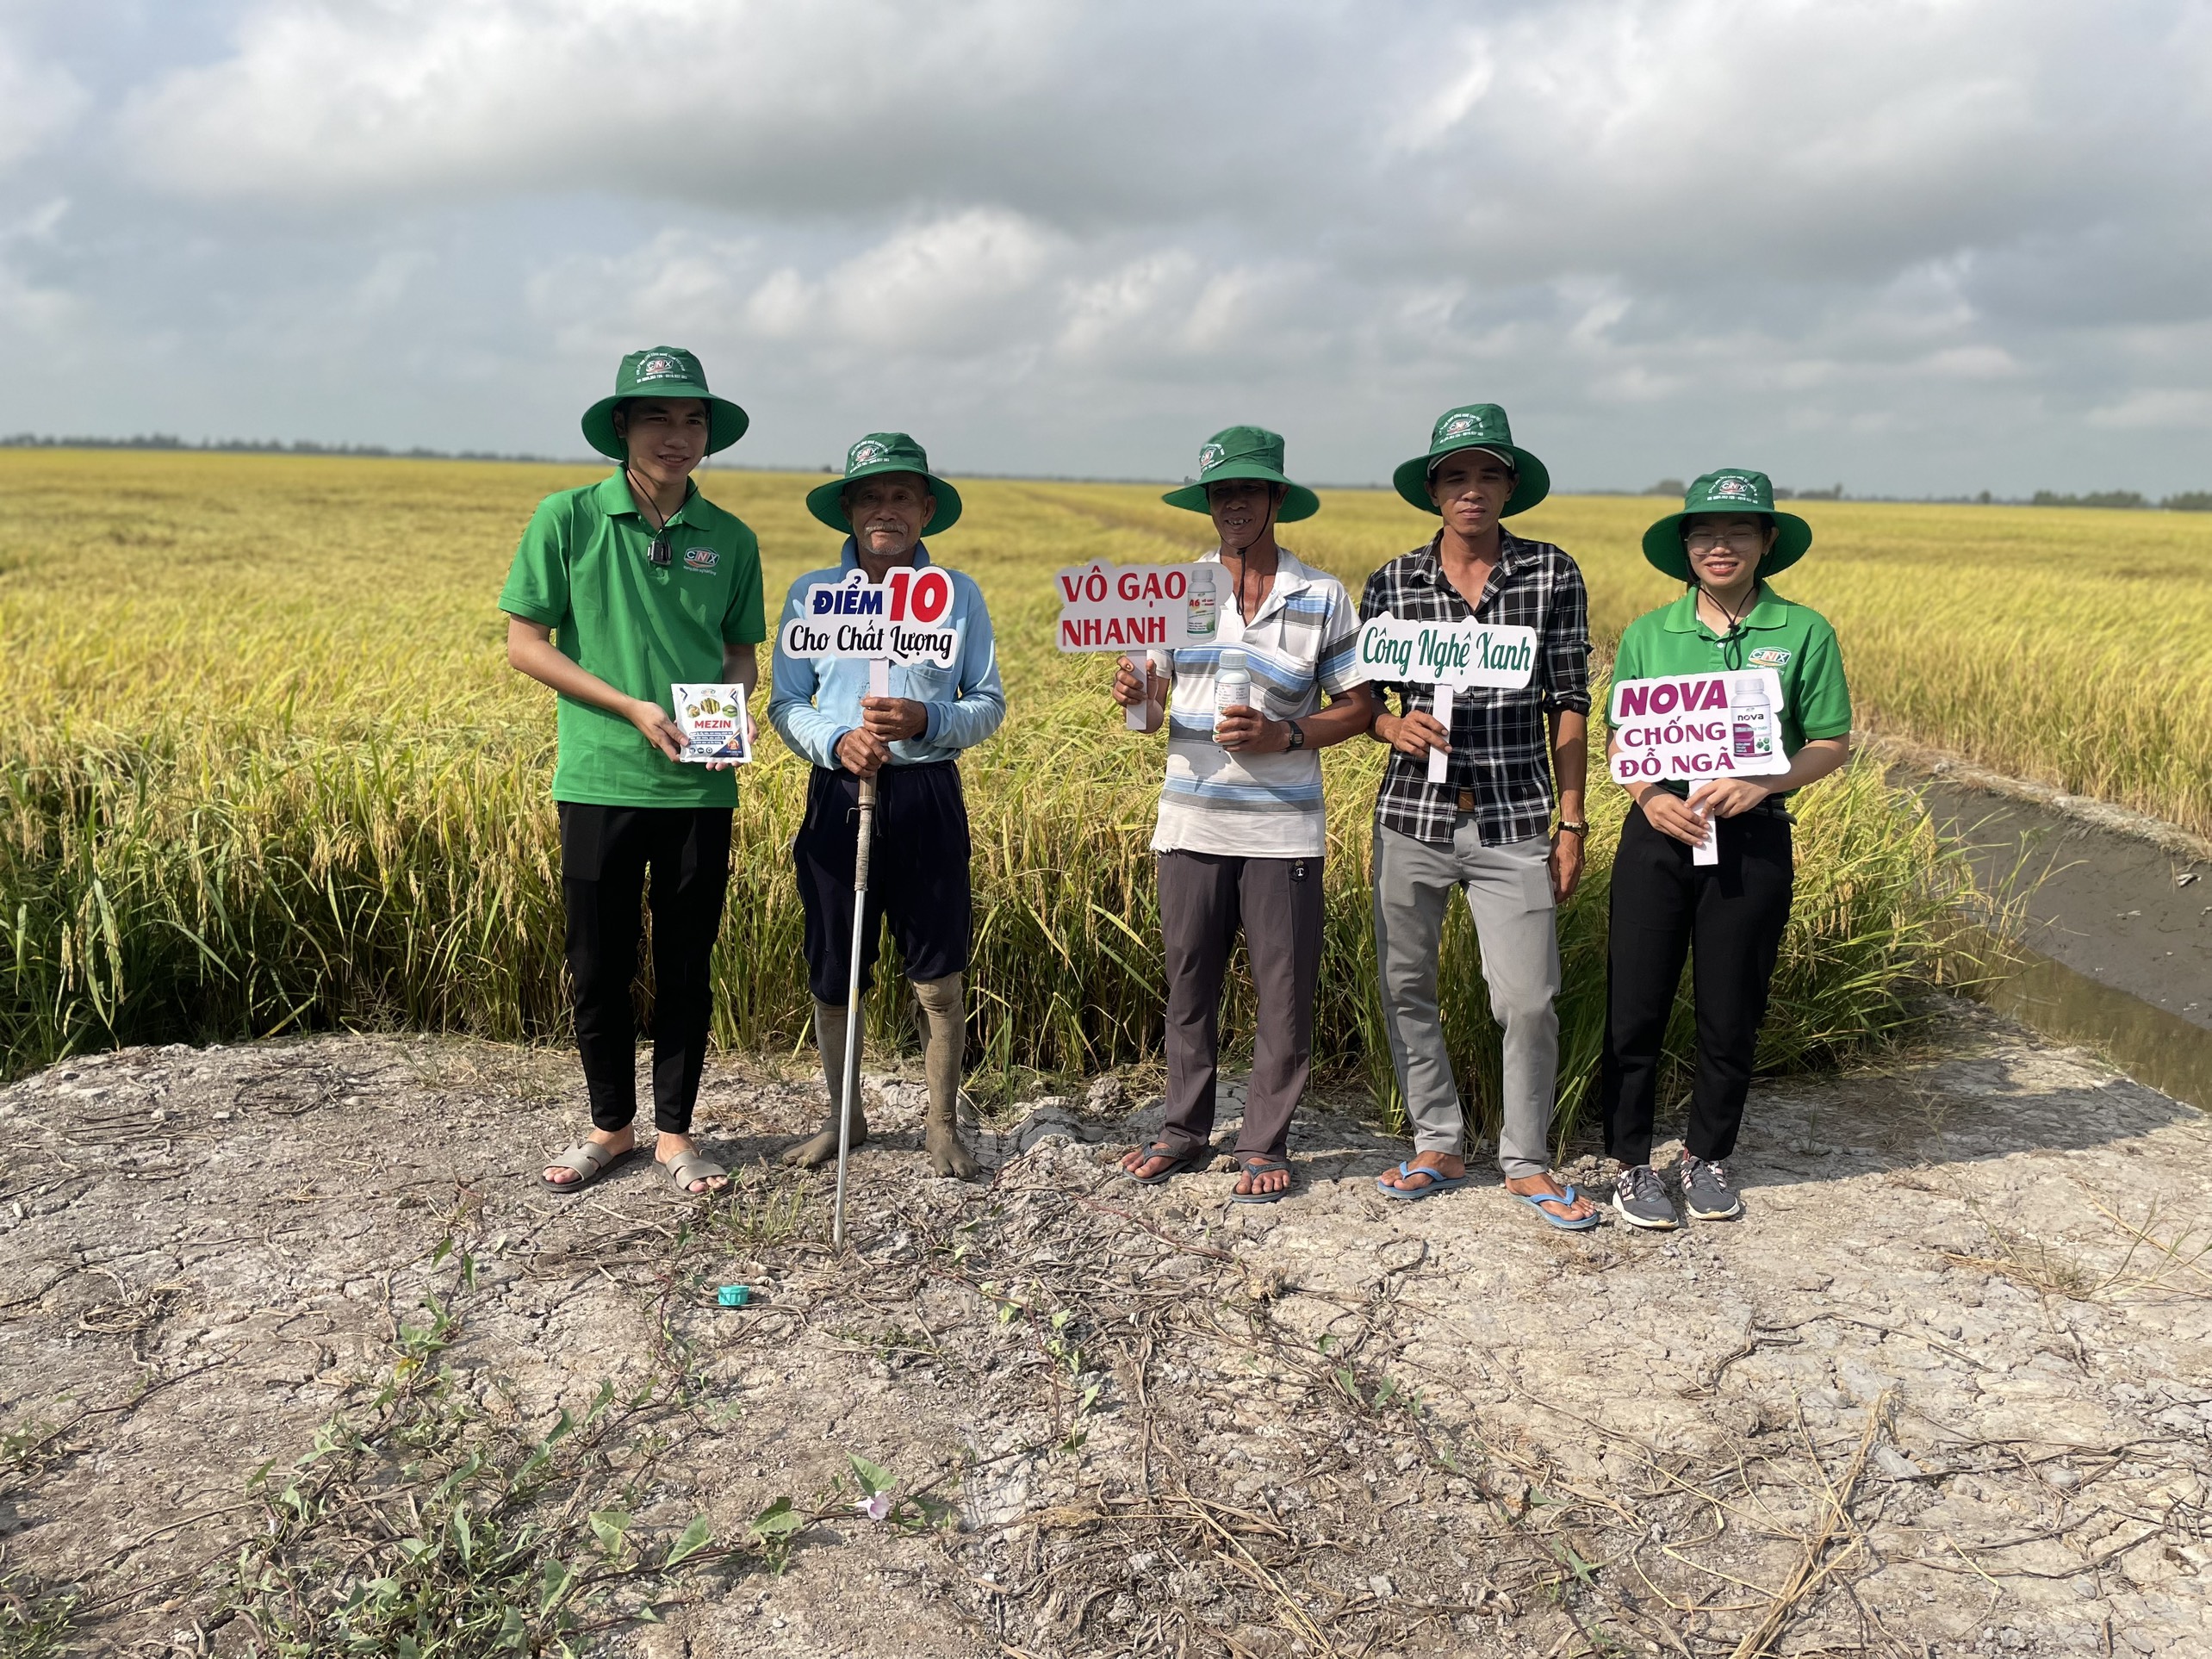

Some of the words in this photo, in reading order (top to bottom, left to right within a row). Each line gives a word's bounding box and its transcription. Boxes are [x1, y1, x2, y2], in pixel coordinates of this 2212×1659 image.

[648, 359, 672, 370] CNX
[1721, 482, 1746, 492] CNX
[687, 550, 718, 564] CNX
[812, 575, 883, 615] ĐIỂM
[889, 572, 948, 623] 10
[1061, 565, 1108, 603] VÔ
[1117, 570, 1187, 609] GẠO
[790, 624, 831, 652] Cho
[837, 618, 885, 652] Chất
[890, 624, 953, 660] Lượng
[1062, 616, 1166, 648] NHANH
[1362, 626, 1413, 677] Công
[1418, 628, 1472, 679] Nghệ
[1476, 631, 1532, 672] Xanh
[1752, 650, 1788, 663] CNX
[1619, 679, 1729, 718] NOVA
[694, 719, 731, 729] MEZIN
[1624, 715, 1727, 748] CHỐNG
[1619, 747, 1662, 778] ĐỖ
[1672, 747, 1736, 774] NGÃ
